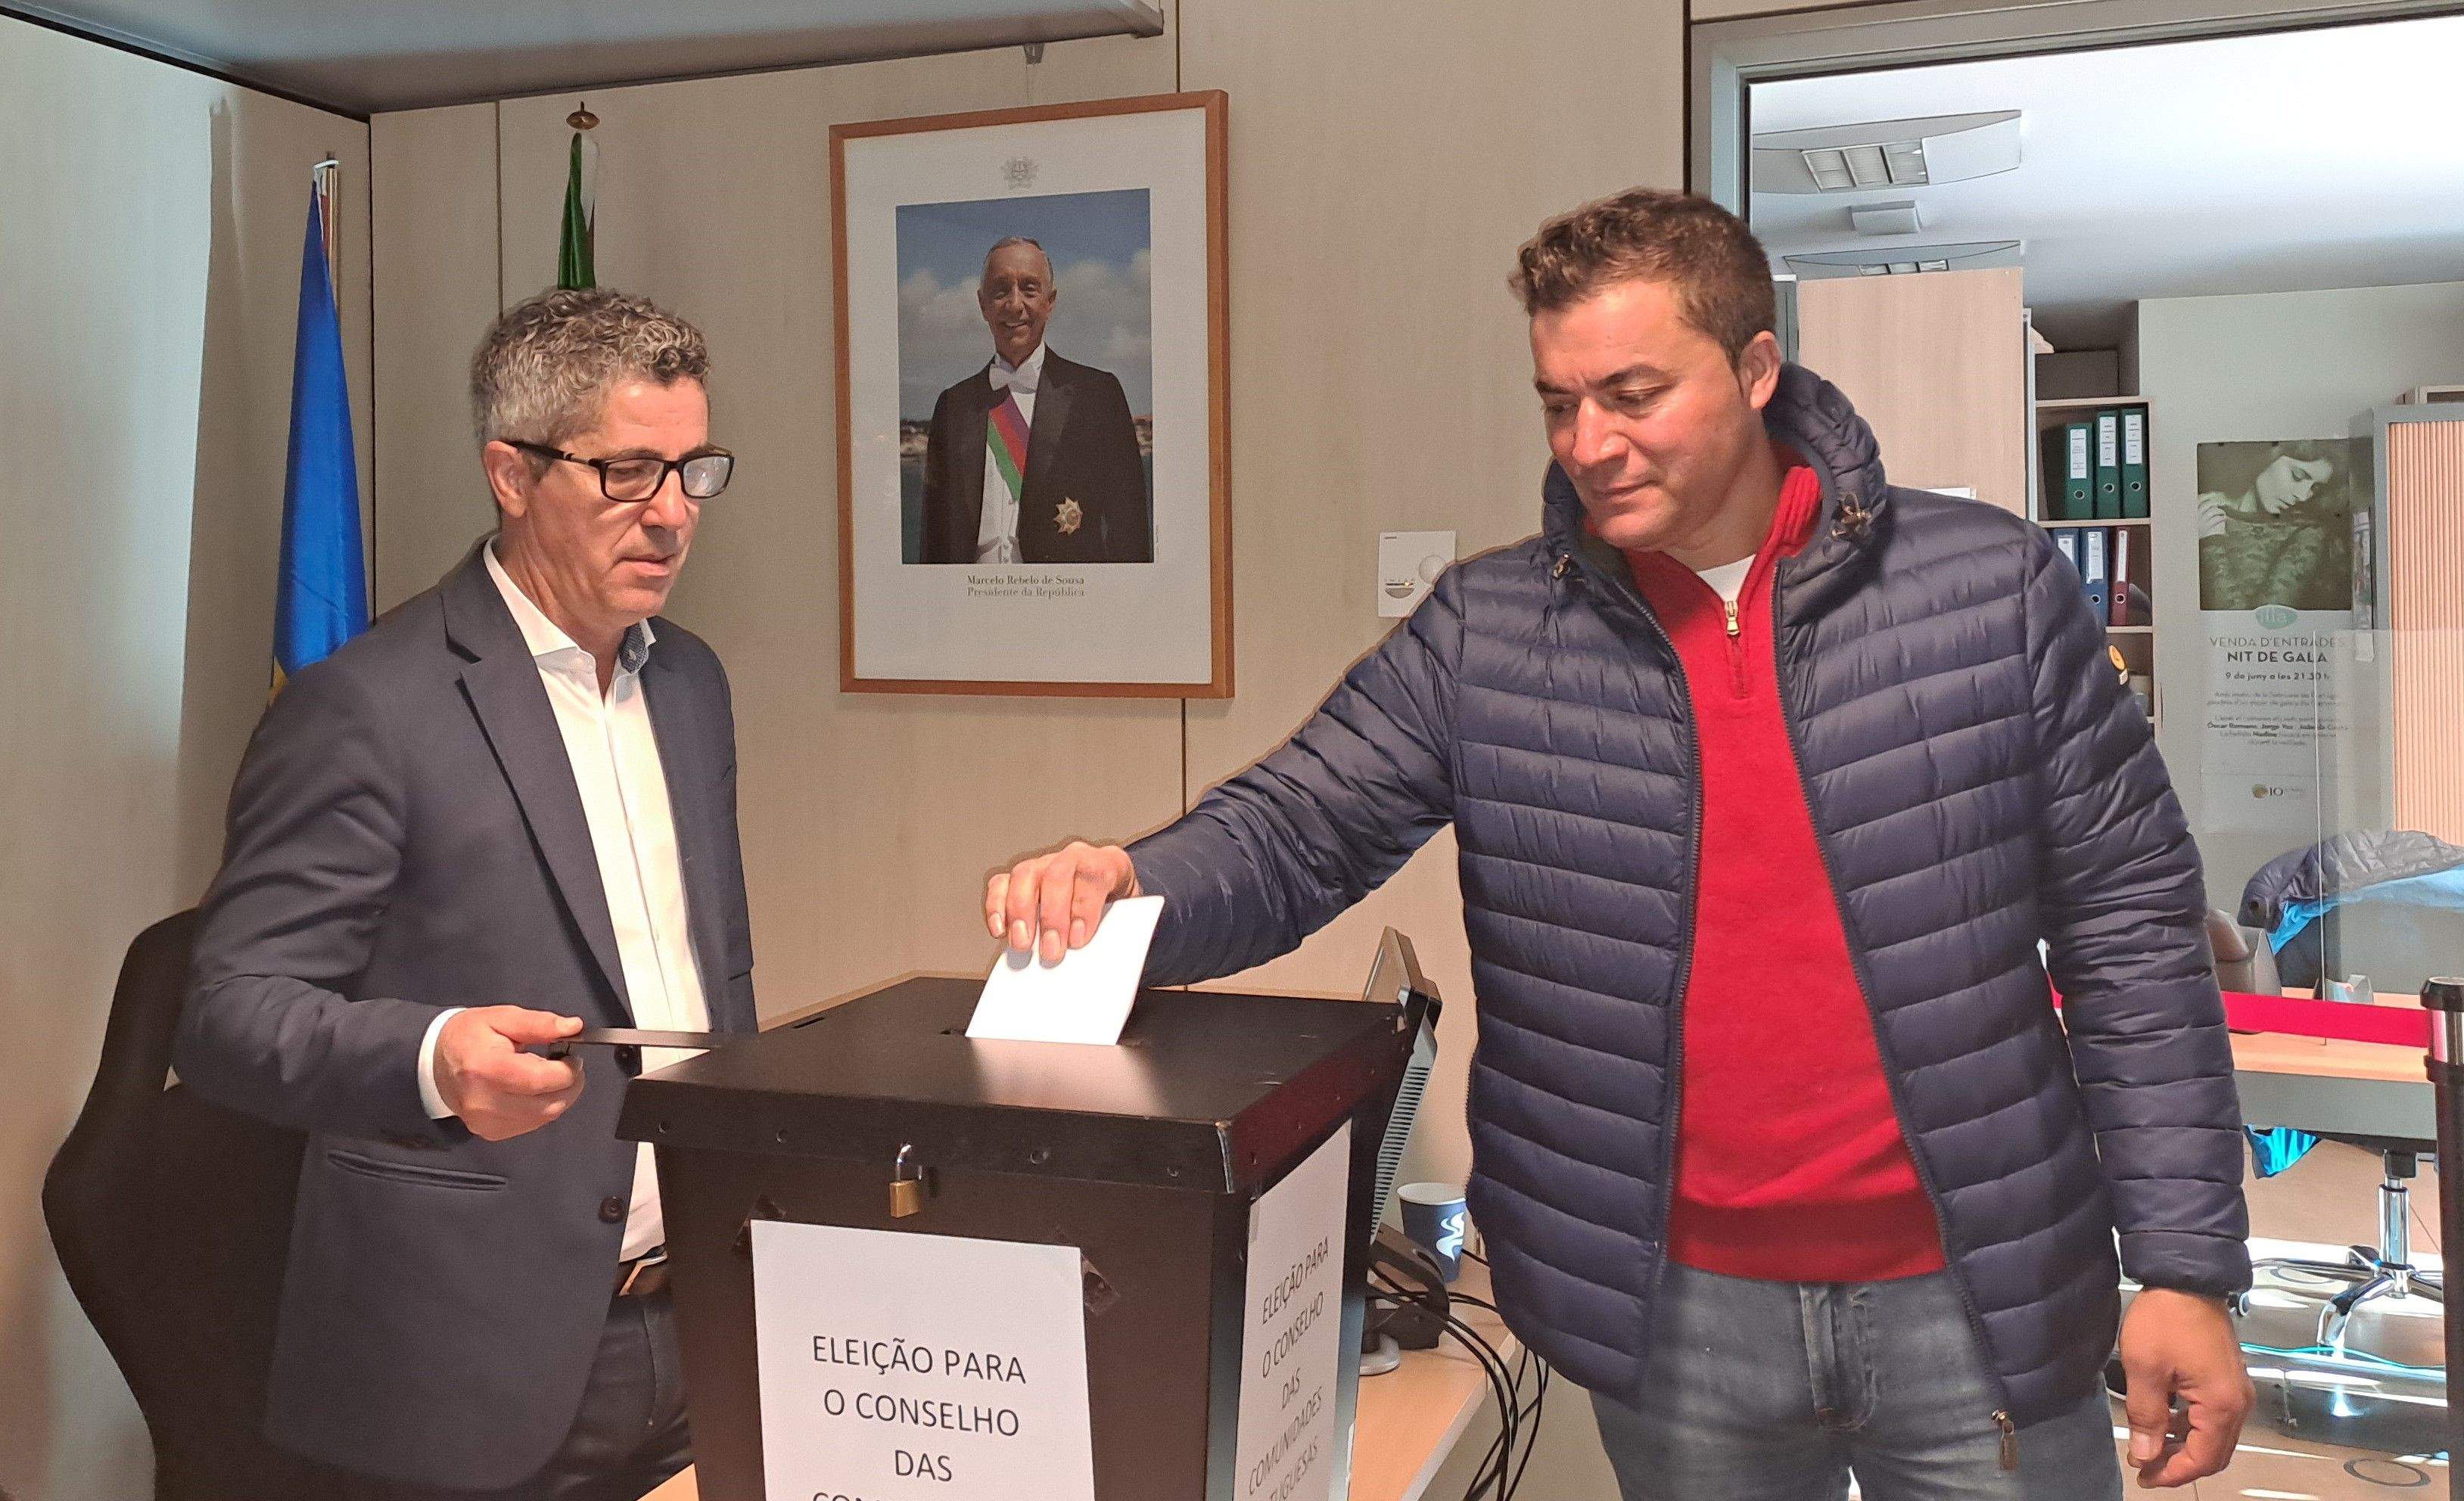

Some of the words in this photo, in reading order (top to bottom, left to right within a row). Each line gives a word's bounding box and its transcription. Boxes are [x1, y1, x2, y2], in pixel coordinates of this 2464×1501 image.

[967, 575, 1004, 585] Marcelo
[1007, 574, 1039, 585] Rebelo
[1041, 574, 1053, 585] de
[1056, 575, 1084, 585] Sousa
[967, 587, 1019, 597] Presidente
[1021, 587, 1033, 597] da
[2210, 638, 2257, 648] VENDA
[2227, 651, 2253, 663] NIT
[2257, 651, 2278, 663] DE
[2283, 651, 2328, 663] GALA
[2248, 672, 2267, 682] juny
[2278, 672, 2291, 680] les
[1262, 1263, 1303, 1325] ELEIÇÃO
[1305, 1236, 1328, 1279] PARA
[1262, 1350, 1271, 1378] O
[1274, 1291, 1324, 1366] CONSELHO
[814, 1335, 933, 1375] ELEIÇÃO
[944, 1350, 1026, 1384] PARA
[1282, 1367, 1300, 1409] DAS
[823, 1389, 845, 1416] O
[856, 1393, 1019, 1436] CONSELHO
[1249, 1386, 1322, 1495] COMUNIDADES
[894, 1450, 953, 1482] DAS
